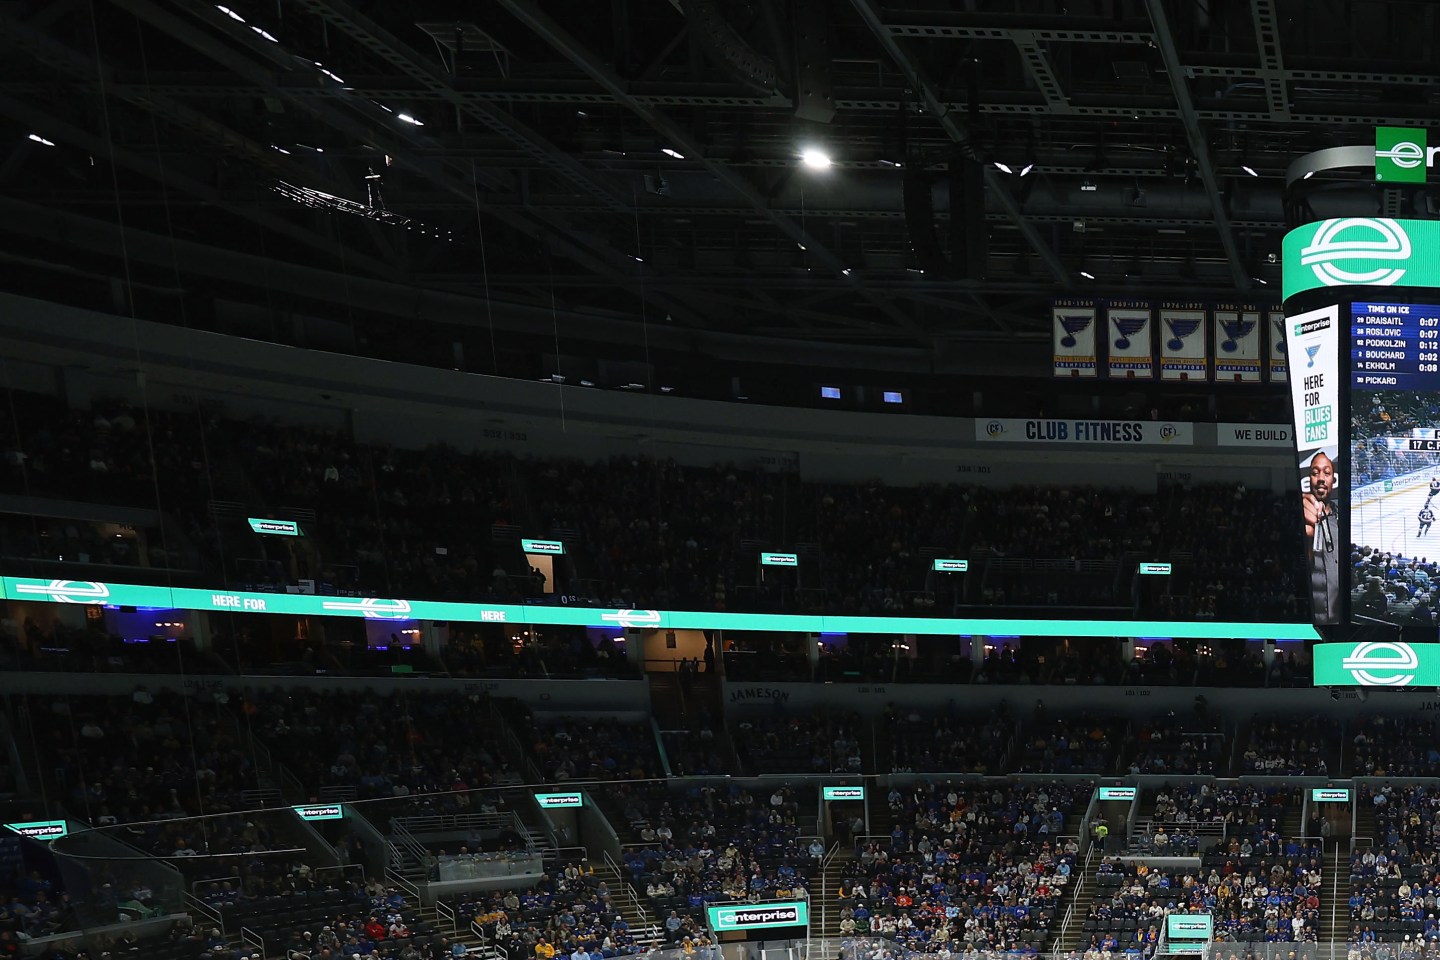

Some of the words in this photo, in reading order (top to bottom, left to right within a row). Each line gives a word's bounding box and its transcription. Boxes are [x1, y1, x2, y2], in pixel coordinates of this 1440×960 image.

[1367, 305, 1385, 313] TIME
[1386, 305, 1397, 314] ON
[1398, 306, 1410, 314] ICE
[1365, 317, 1403, 325] DRAISAITL
[1419, 318, 1439, 326] 0:07
[1365, 328, 1402, 336] ROSLOVIC
[1419, 330, 1439, 338] 0:07
[1365, 339, 1406, 348] PODKOLZIN
[1419, 341, 1438, 349] 0:12
[1365, 350, 1405, 359] BOUCHARD
[1419, 353, 1438, 361] 0:02
[1365, 362, 1396, 370] EKHOLM
[1418, 364, 1438, 372] 0:08
[1304, 373, 1324, 391] HERE
[1365, 376, 1397, 385] PICKARD
[1304, 391, 1320, 407] FOR
[1305, 407, 1331, 424] BLUES
[1025, 421, 1068, 440] CLUB
[1075, 421, 1143, 441] FITNESS
[1234, 429, 1252, 440] WE
[1255, 430, 1287, 441] BUILD
[1305, 426, 1327, 442] FANS
[1412, 441, 1422, 450] 17
[212, 595, 240, 608] HERE
[244, 597, 266, 611] FOR
[481, 610, 506, 622] HERE
[730, 687, 790, 702] JAMESON
[722, 910, 796, 922] enterprise
